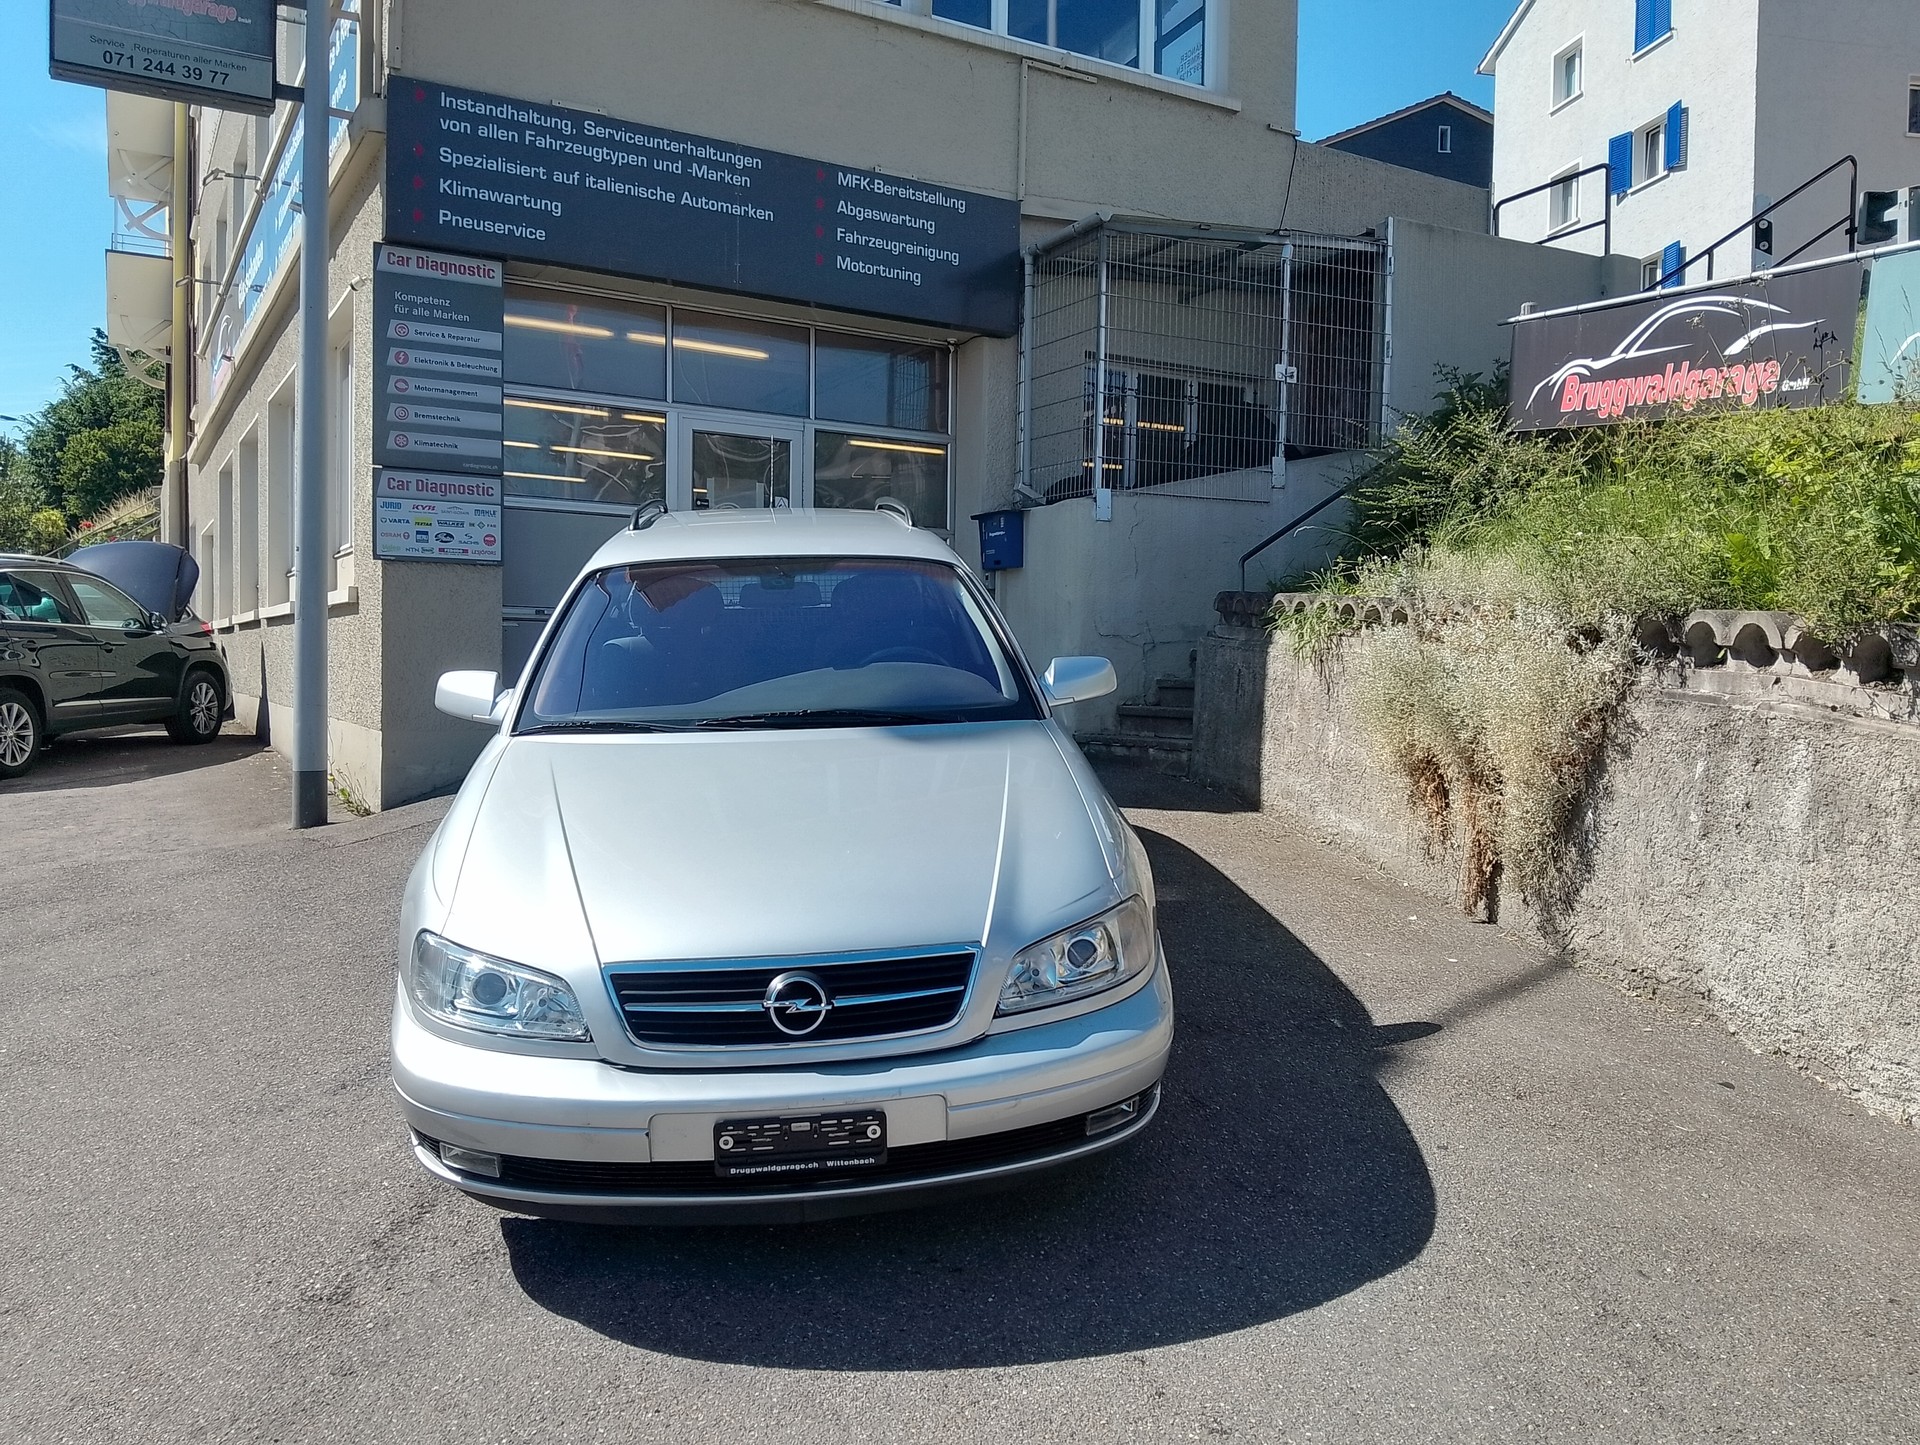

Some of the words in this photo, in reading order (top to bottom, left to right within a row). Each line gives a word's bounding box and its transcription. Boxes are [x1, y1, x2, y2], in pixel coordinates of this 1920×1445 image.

[89, 35, 125, 49] Service
[193, 55, 212, 65] aller
[214, 59, 248, 72] Marken
[102, 50, 135, 69] 071
[143, 58, 176, 76] 244
[182, 65, 203, 81] 39
[209, 69, 230, 85] 77
[440, 91, 577, 135] Instandhaltung,
[583, 120, 763, 170] Serviceunterhaltungen
[439, 117, 471, 135] von
[477, 123, 519, 144] allen
[525, 130, 648, 168] Fahrzeugtypen
[653, 156, 682, 174] und
[687, 163, 751, 188] -Marken
[439, 147, 547, 180] Spezialisiert
[552, 169, 580, 187] auf
[585, 175, 676, 204] italienische
[680, 191, 775, 222] Automarken
[439, 178, 562, 217] Klimawartung
[837, 171, 966, 213] MFK-Bereitstellung
[438, 209, 547, 241] Pneuservice
[836, 200, 936, 235] Abgaswartung
[836, 227, 960, 265] Fahrzeugreinigung
[386, 251, 412, 268] Car
[416, 255, 496, 280] Diagnostic
[836, 255, 922, 286] Motortuning
[394, 290, 450, 307] Kompetenz
[394, 304, 410, 315] für
[412, 307, 430, 317] alle
[433, 309, 470, 322] Marken
[414, 328, 440, 338] Service
[447, 333, 481, 343] Reparatur
[414, 356, 449, 367] Elektronik
[456, 361, 498, 373] Beleuchtung
[414, 384, 478, 398] Motormanagement
[1560, 360, 1781, 418] Bruggwaldgarage
[414, 411, 461, 422] Bremstechnik
[414, 439, 459, 450] Klimatechnik
[387, 476, 412, 492] Car
[415, 478, 495, 498] Diagnostic
[380, 501, 402, 510] JURID
[730, 1162, 819, 1174] Bruggwaldgarage.ch
[826, 1157, 875, 1167] Wittenbach
